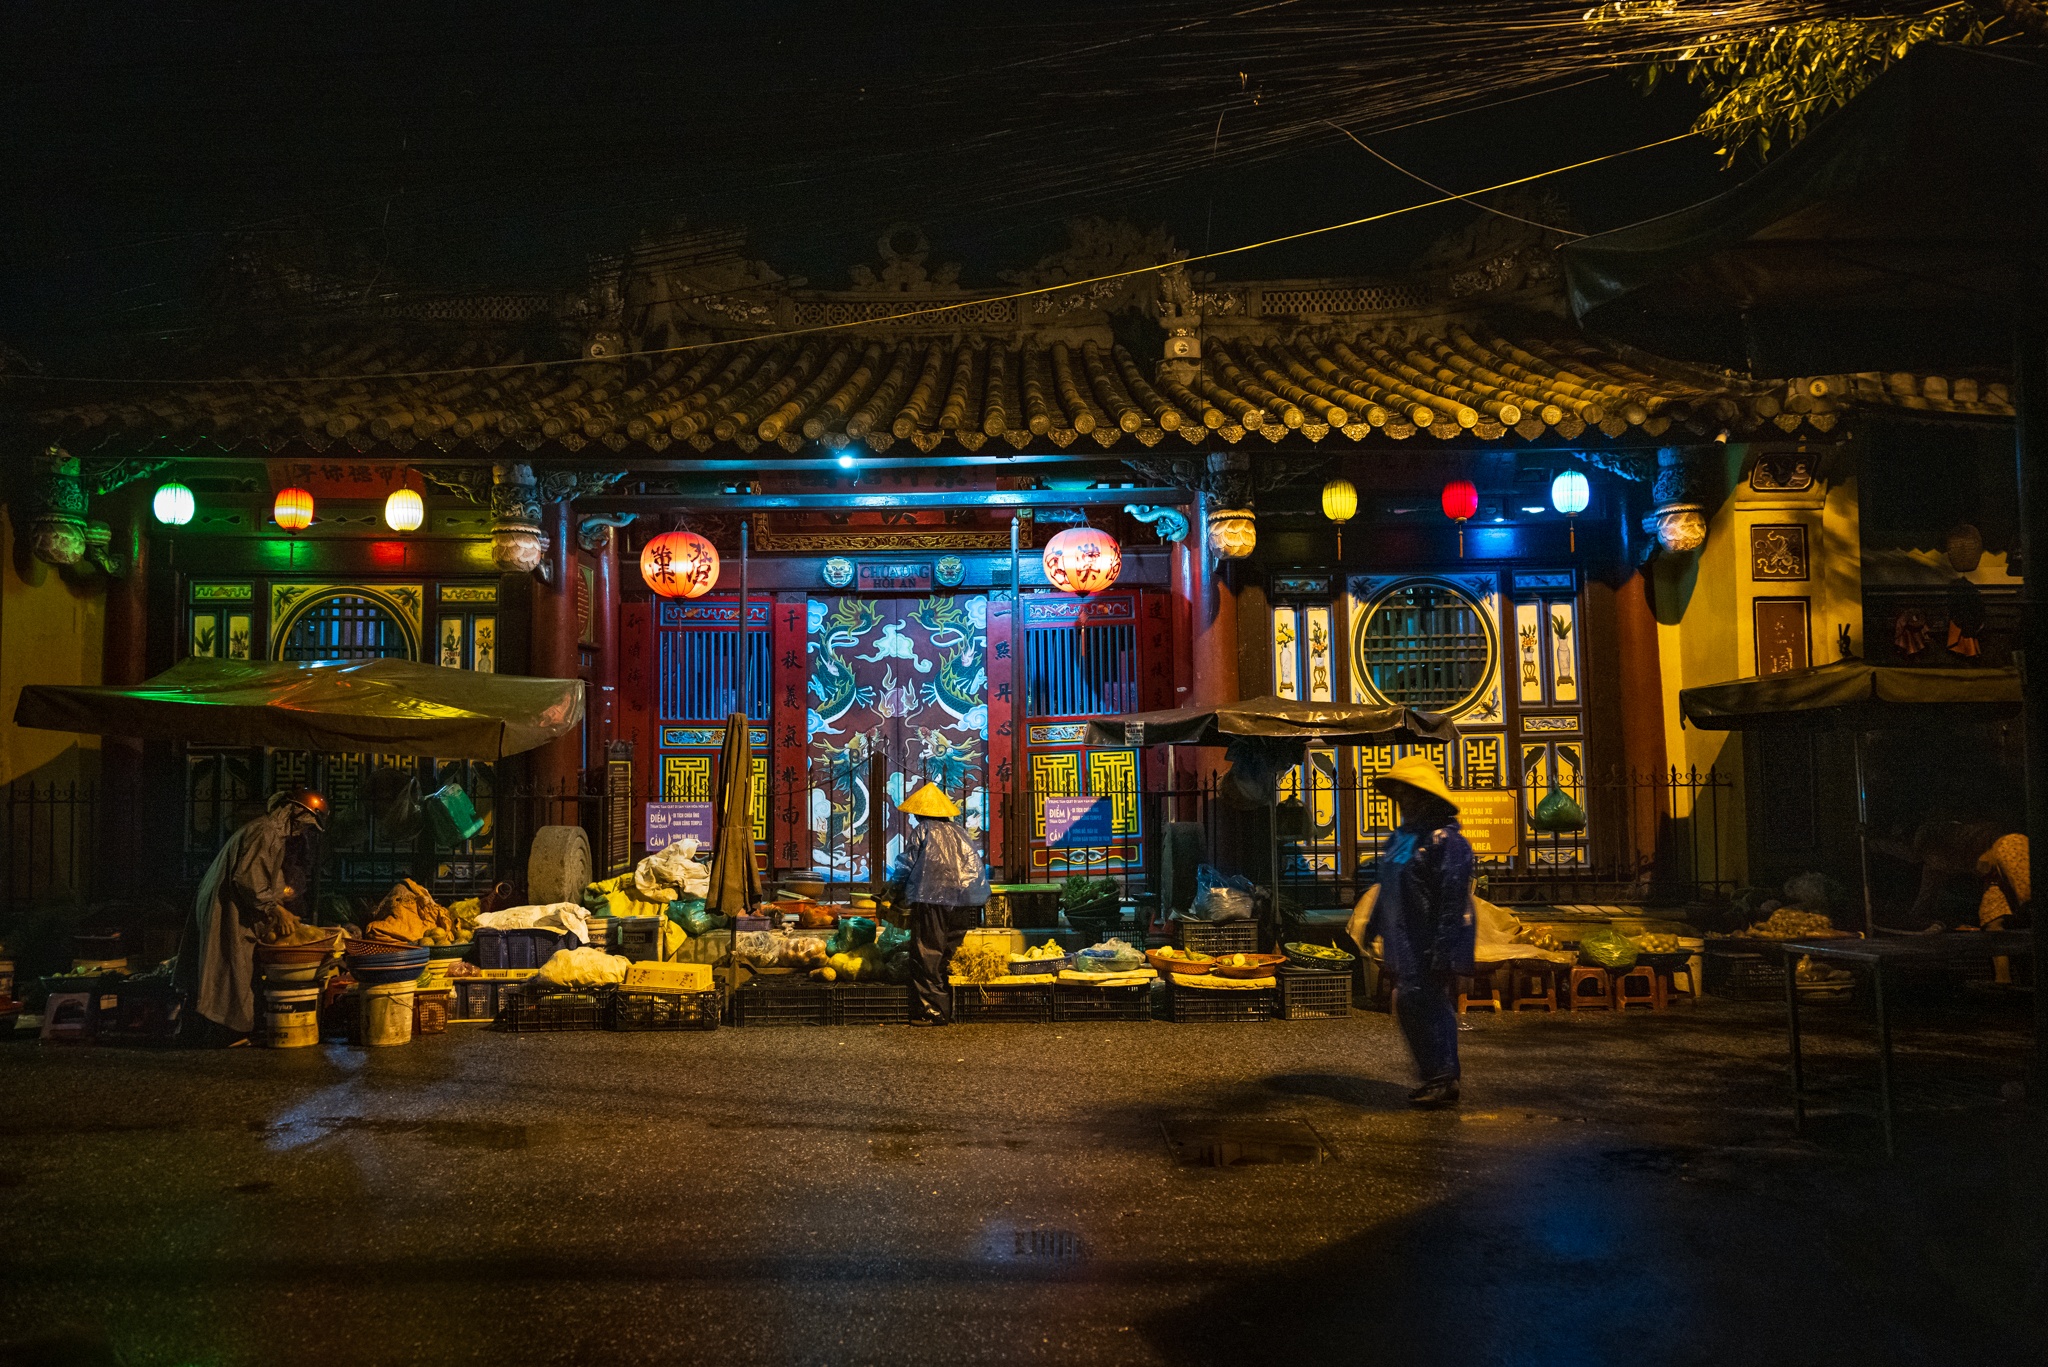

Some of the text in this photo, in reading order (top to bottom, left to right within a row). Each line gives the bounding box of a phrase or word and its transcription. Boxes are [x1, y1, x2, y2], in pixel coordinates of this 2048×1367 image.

[899, 579, 917, 588] AN
[1460, 807, 1468, 815] ÁC
[1472, 842, 1491, 850] AREA
